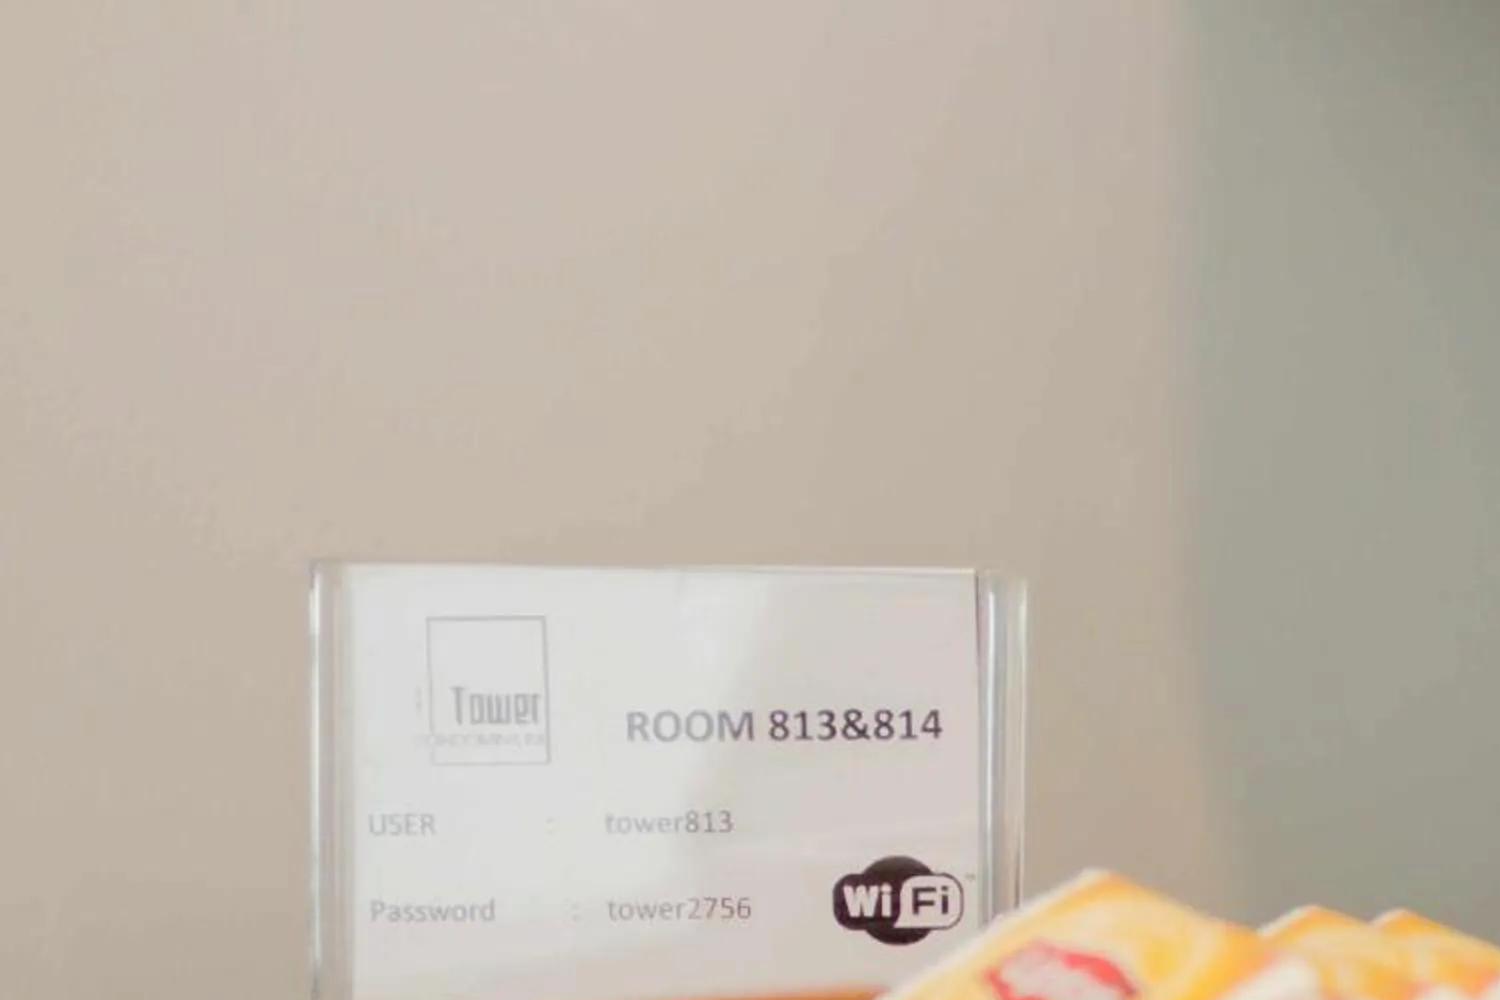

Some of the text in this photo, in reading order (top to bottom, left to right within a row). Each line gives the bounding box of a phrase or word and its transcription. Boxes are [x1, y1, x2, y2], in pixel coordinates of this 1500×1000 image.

[450, 685, 544, 726] Tower
[626, 708, 944, 743] ROOM 813&814
[368, 813, 438, 836] USER
[605, 811, 734, 834] tower813
[371, 899, 496, 923] Password
[607, 897, 753, 921] tower2756
